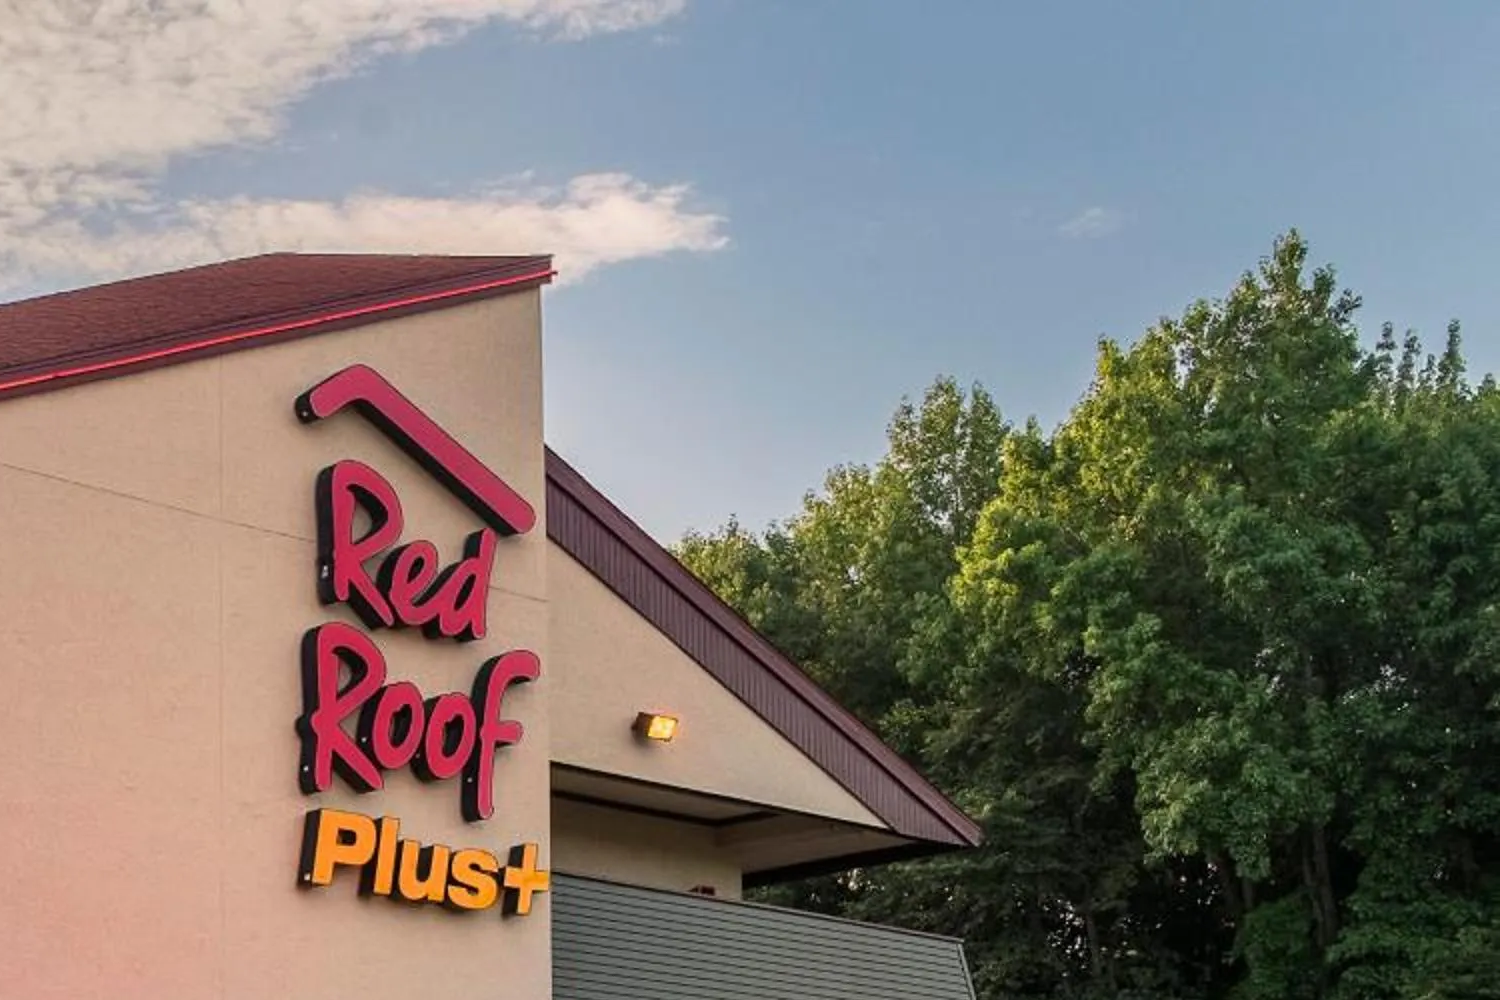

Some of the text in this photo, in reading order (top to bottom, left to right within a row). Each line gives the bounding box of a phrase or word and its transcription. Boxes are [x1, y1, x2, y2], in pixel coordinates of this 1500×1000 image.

[320, 459, 498, 641] Red
[300, 621, 541, 821] Roof
[302, 807, 550, 916] Plus+
